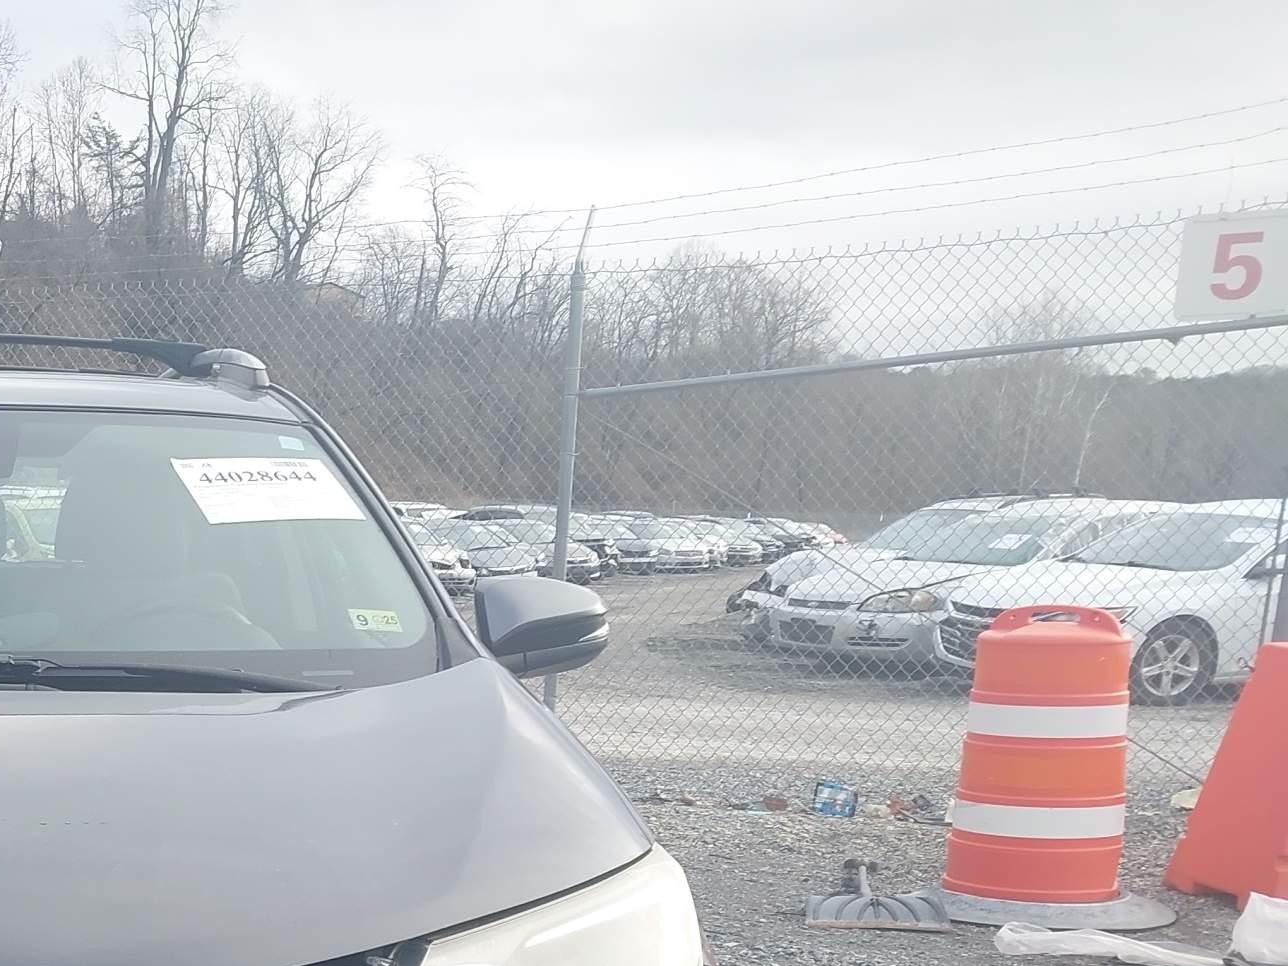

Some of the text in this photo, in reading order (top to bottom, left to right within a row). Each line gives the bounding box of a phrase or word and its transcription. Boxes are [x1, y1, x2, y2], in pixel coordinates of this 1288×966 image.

[1209, 230, 1264, 301] 5
[199, 470, 318, 484] 44028644
[355, 613, 369, 627] 9
